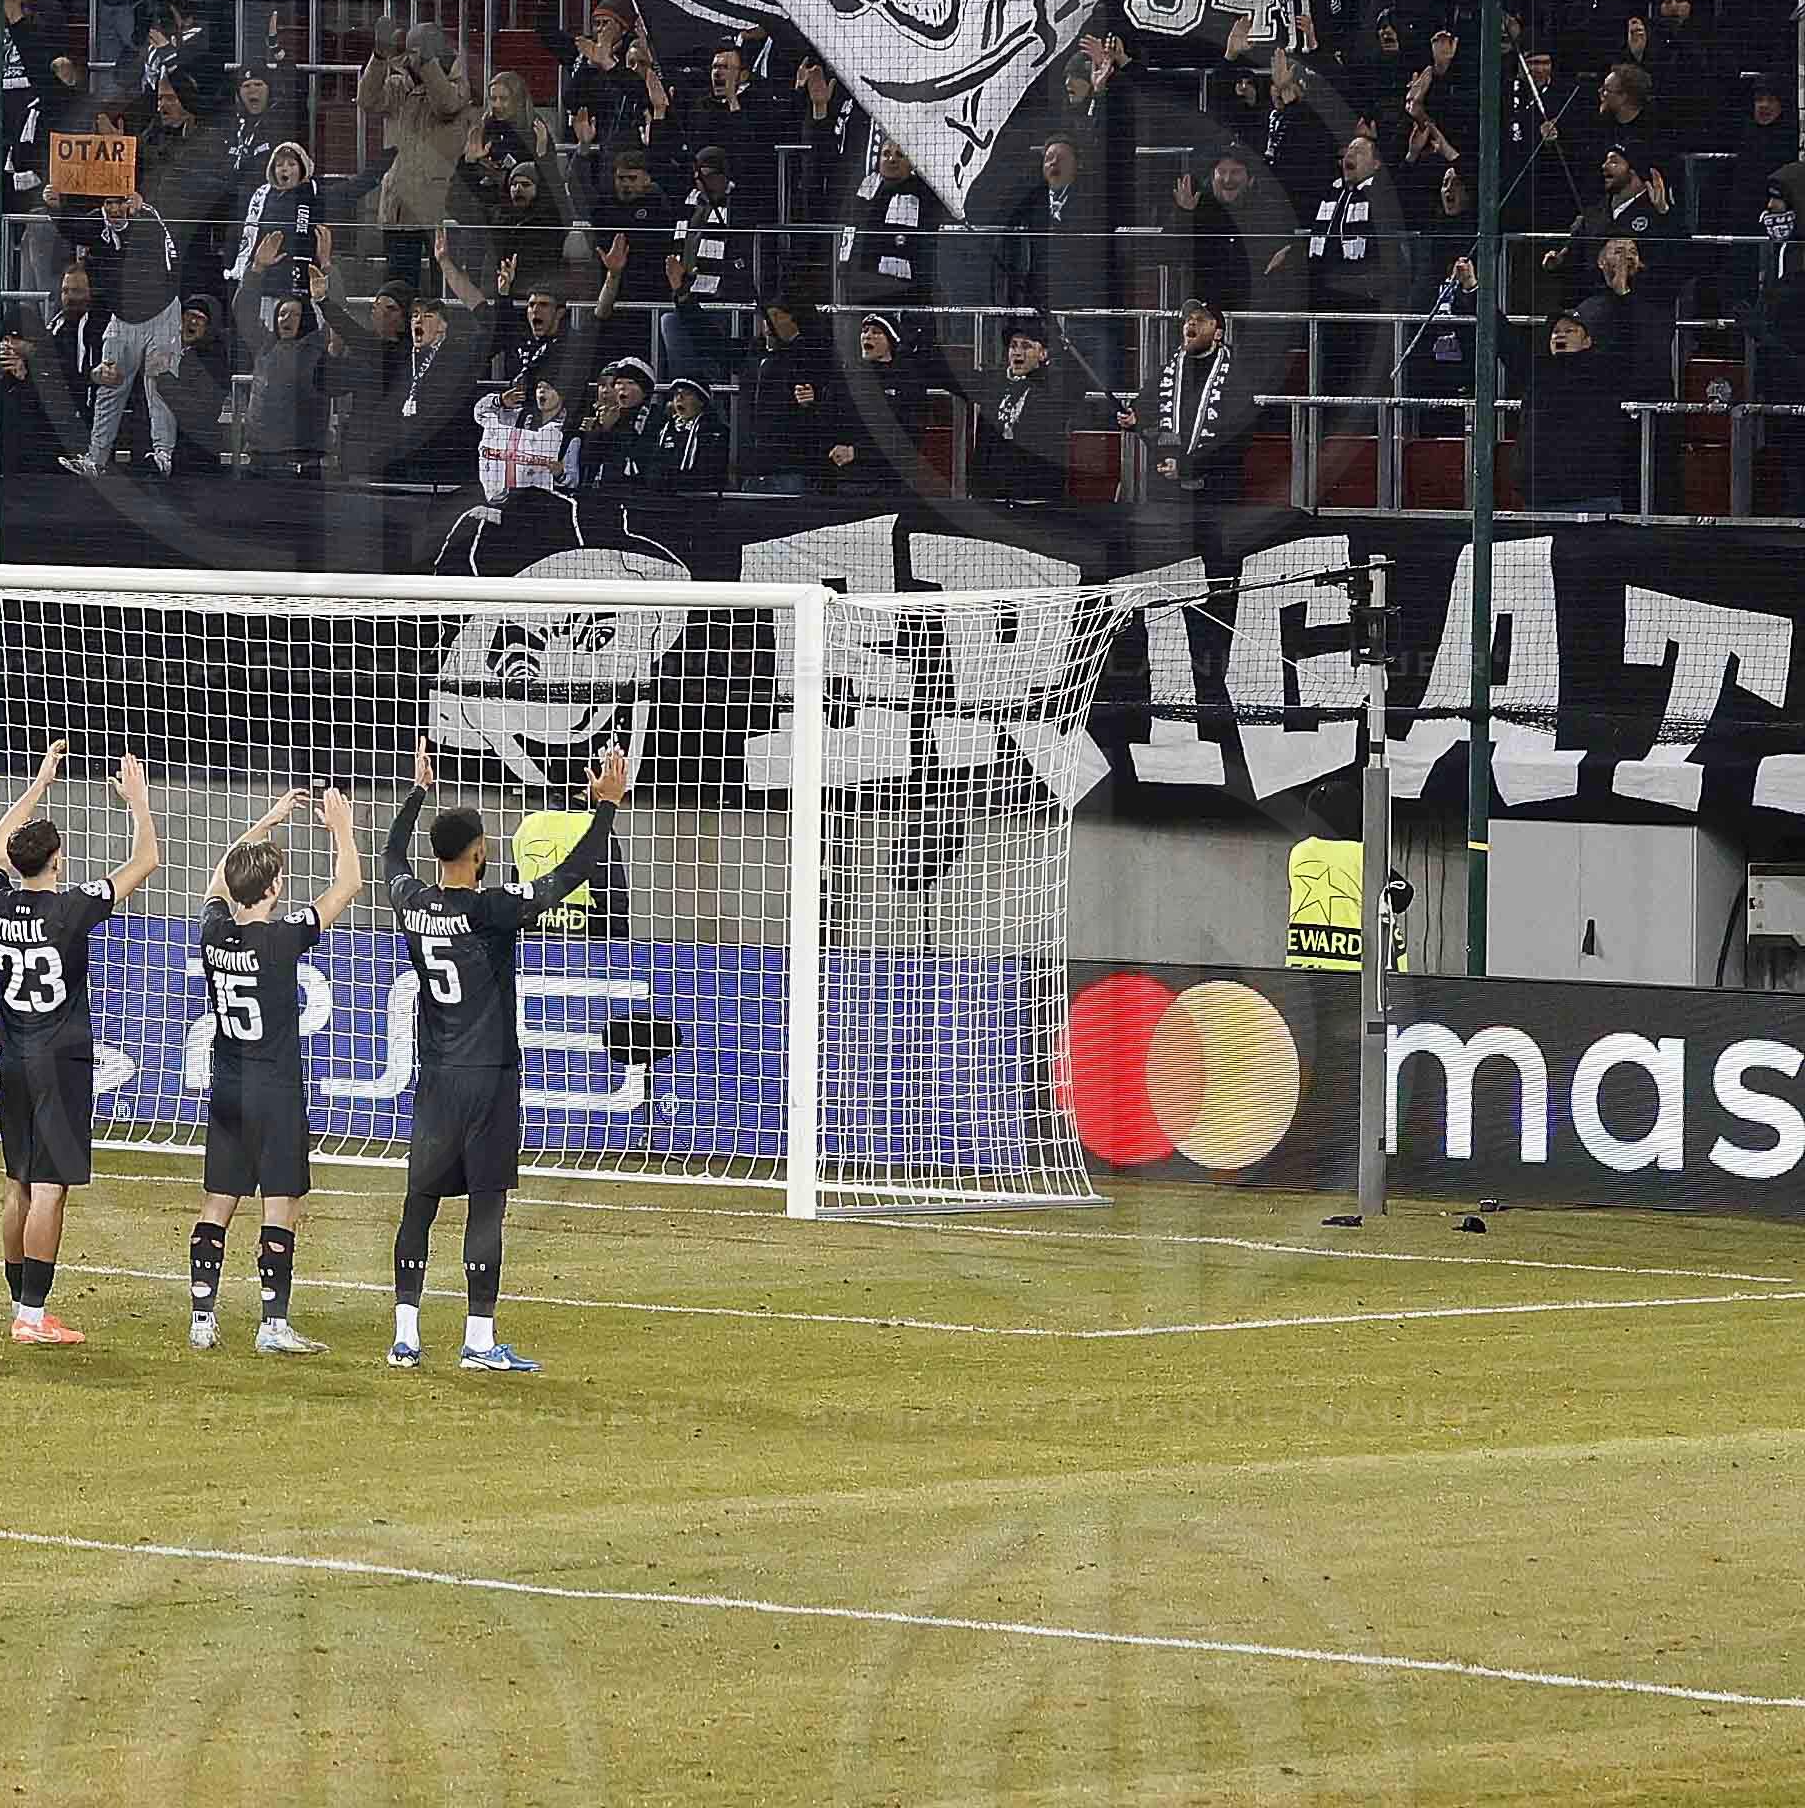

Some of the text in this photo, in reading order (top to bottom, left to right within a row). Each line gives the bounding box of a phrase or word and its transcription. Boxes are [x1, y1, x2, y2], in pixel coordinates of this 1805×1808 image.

[58, 139, 126, 162] OTAR
[421, 936, 463, 1005] 5
[211, 970, 264, 1042] 15
